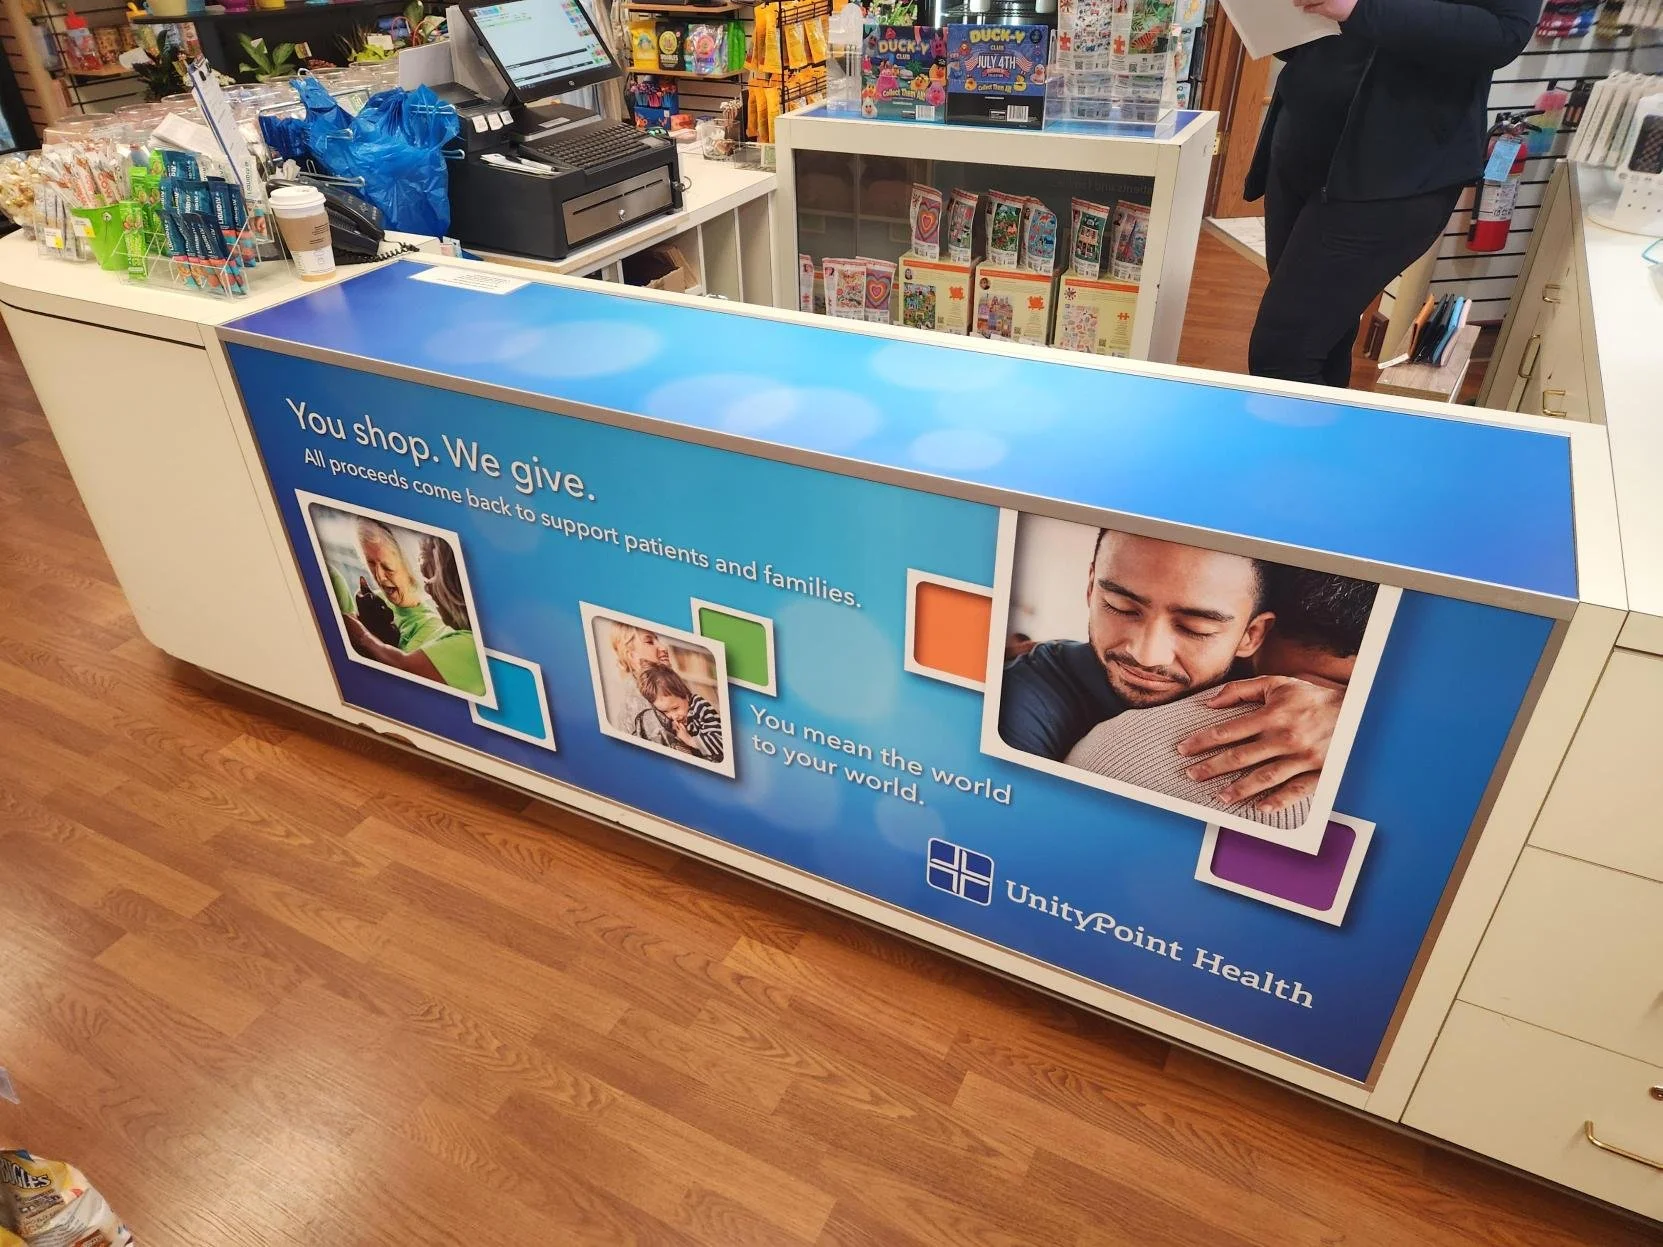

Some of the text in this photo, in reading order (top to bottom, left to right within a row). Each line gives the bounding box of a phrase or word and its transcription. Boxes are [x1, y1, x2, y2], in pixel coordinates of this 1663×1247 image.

[878, 39, 930, 55] DUCK-Y
[969, 28, 1026, 44] DUCK-Y
[977, 55, 1016, 69] JULY 4TH
[286, 397, 597, 501] You shop. We give.
[304, 448, 863, 608] All proceeds come back to support patients and families.
[750, 703, 1013, 805] You mean the world
[752, 735, 926, 805] to your world.
[1006, 880, 1314, 1009] UnityPoint Health
